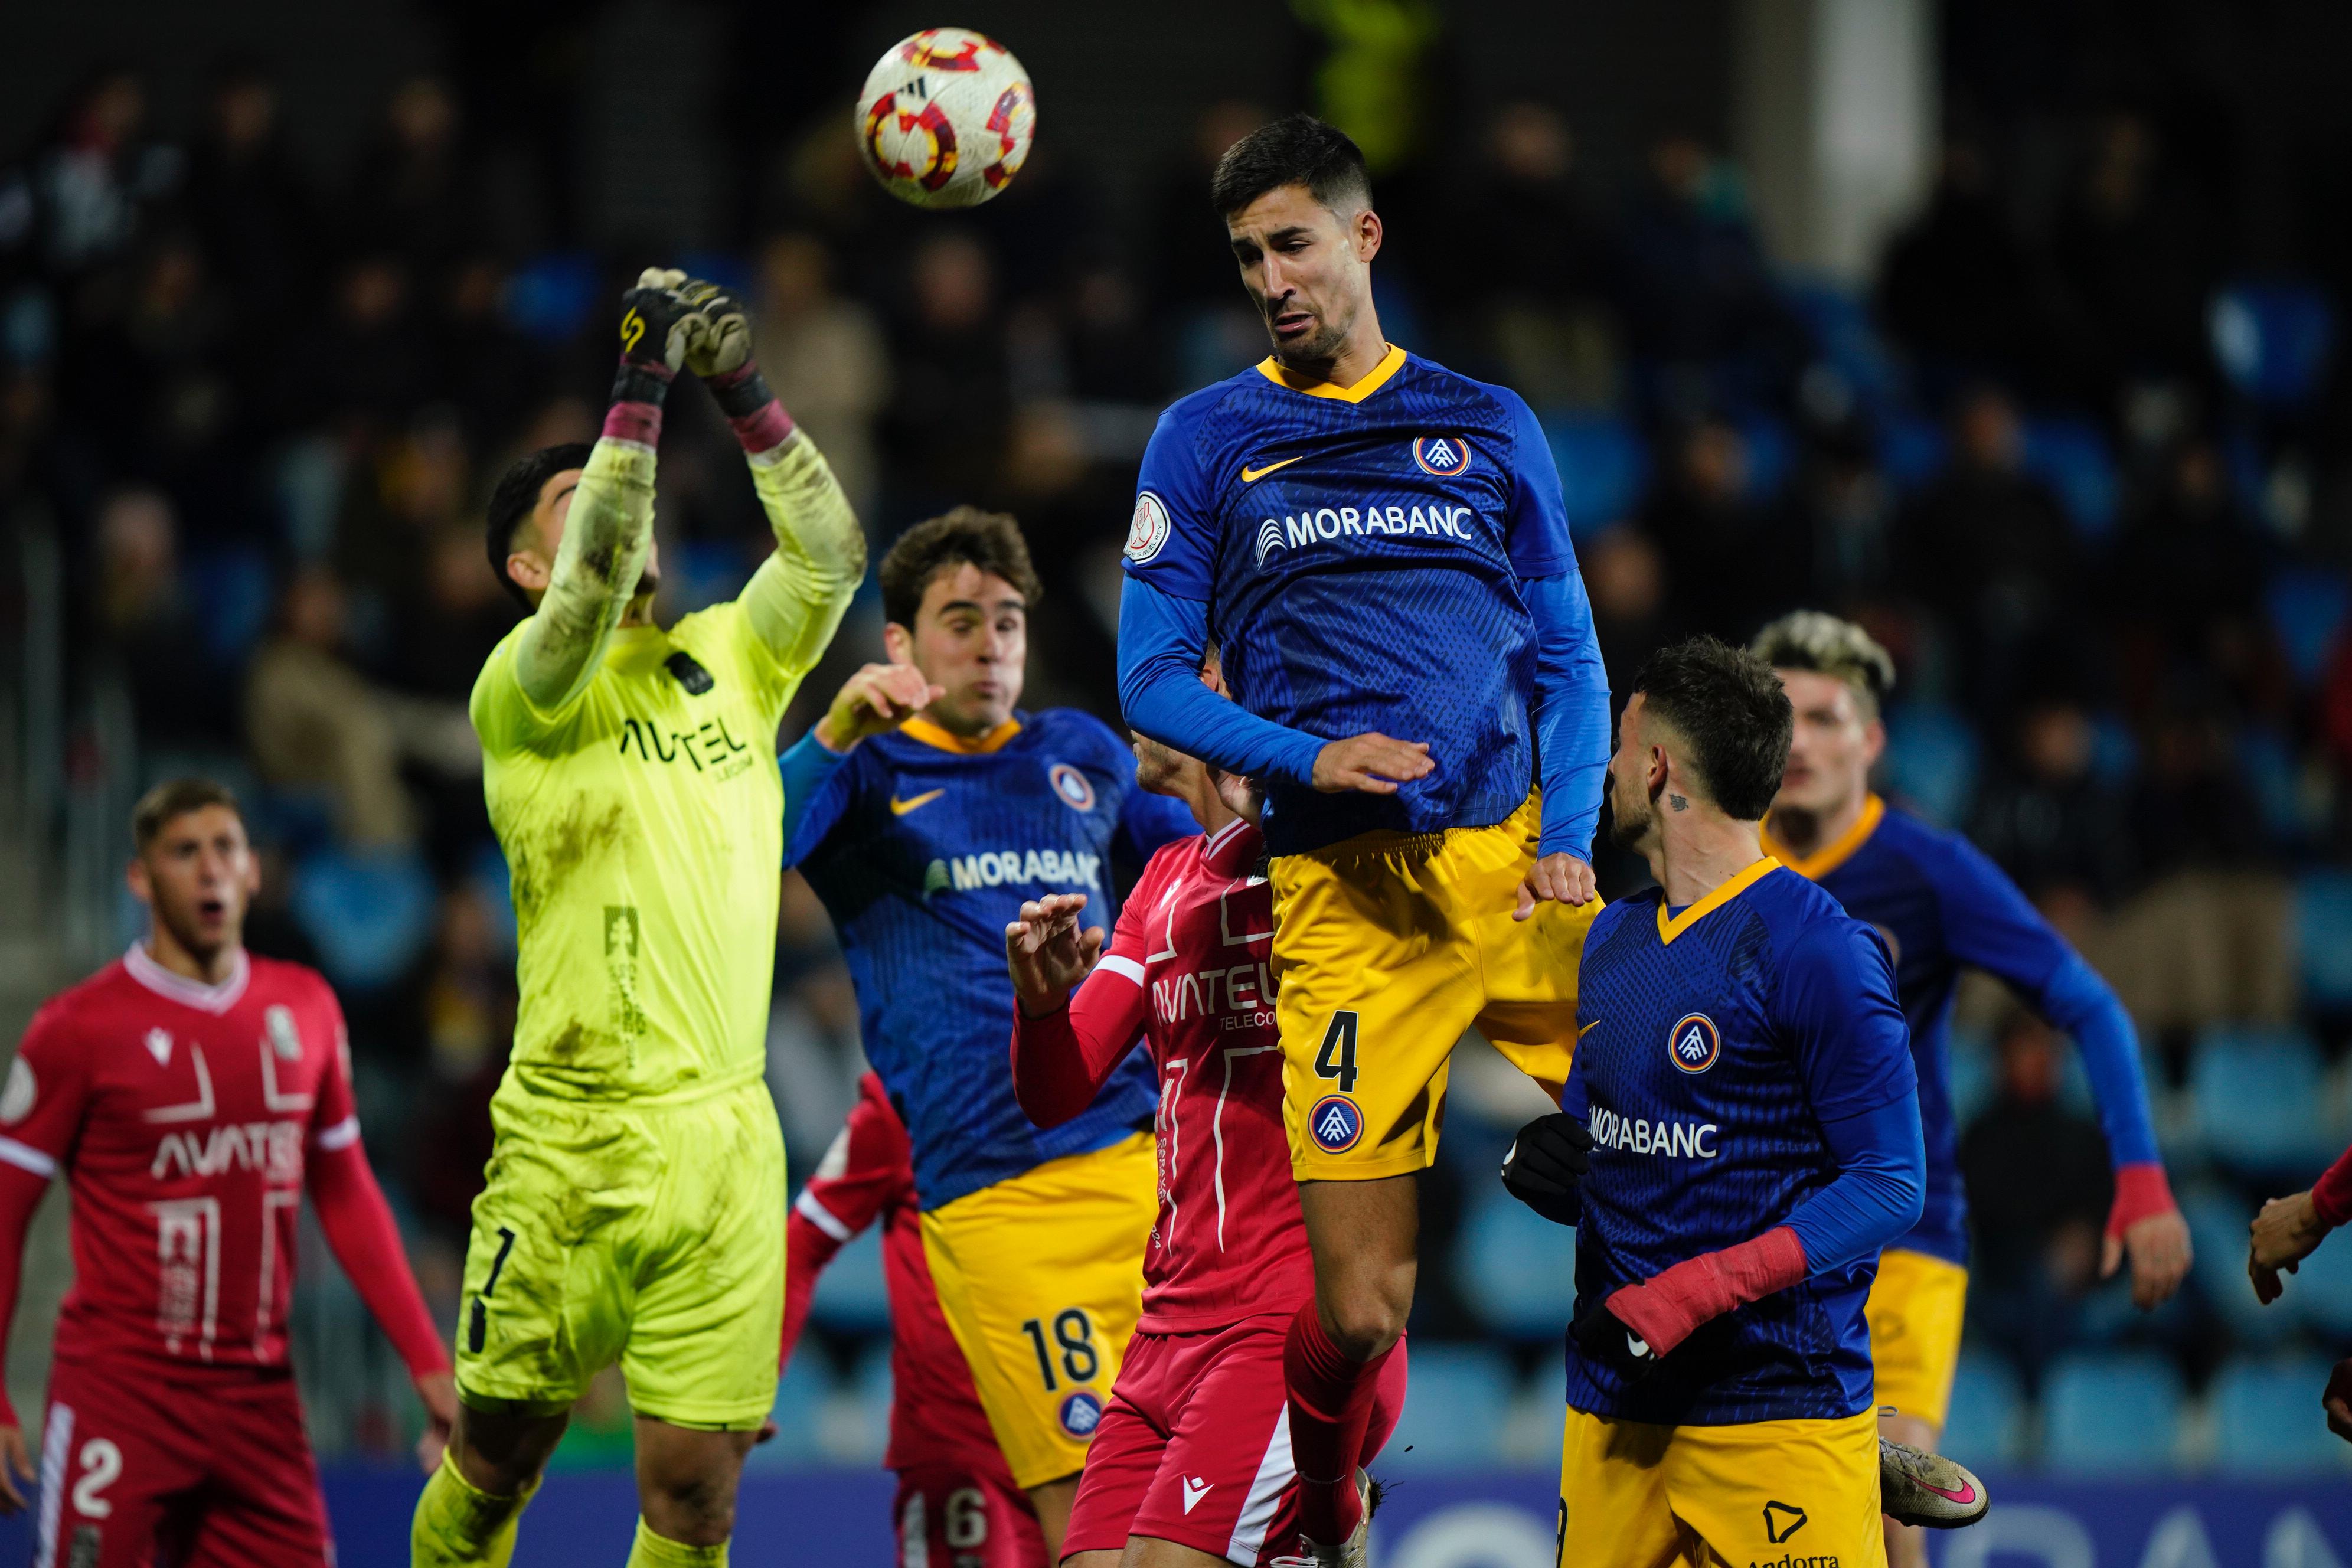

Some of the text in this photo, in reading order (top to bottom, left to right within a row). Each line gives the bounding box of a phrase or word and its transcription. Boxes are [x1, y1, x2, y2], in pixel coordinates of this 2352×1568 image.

[1154, 524, 1163, 541] REY
[1285, 505, 1472, 549] MORABANC
[951, 848, 1101, 891] MORABANC
[1152, 962, 1277, 1027] AVATEL
[1220, 1010, 1278, 1031] TELECO
[1313, 1010, 1359, 1093] 4
[1590, 1105, 1717, 1158] MORABANC
[1021, 1307, 1098, 1393] 18
[71, 1437, 123, 1520] 2
[946, 1487, 987, 1548] 6
